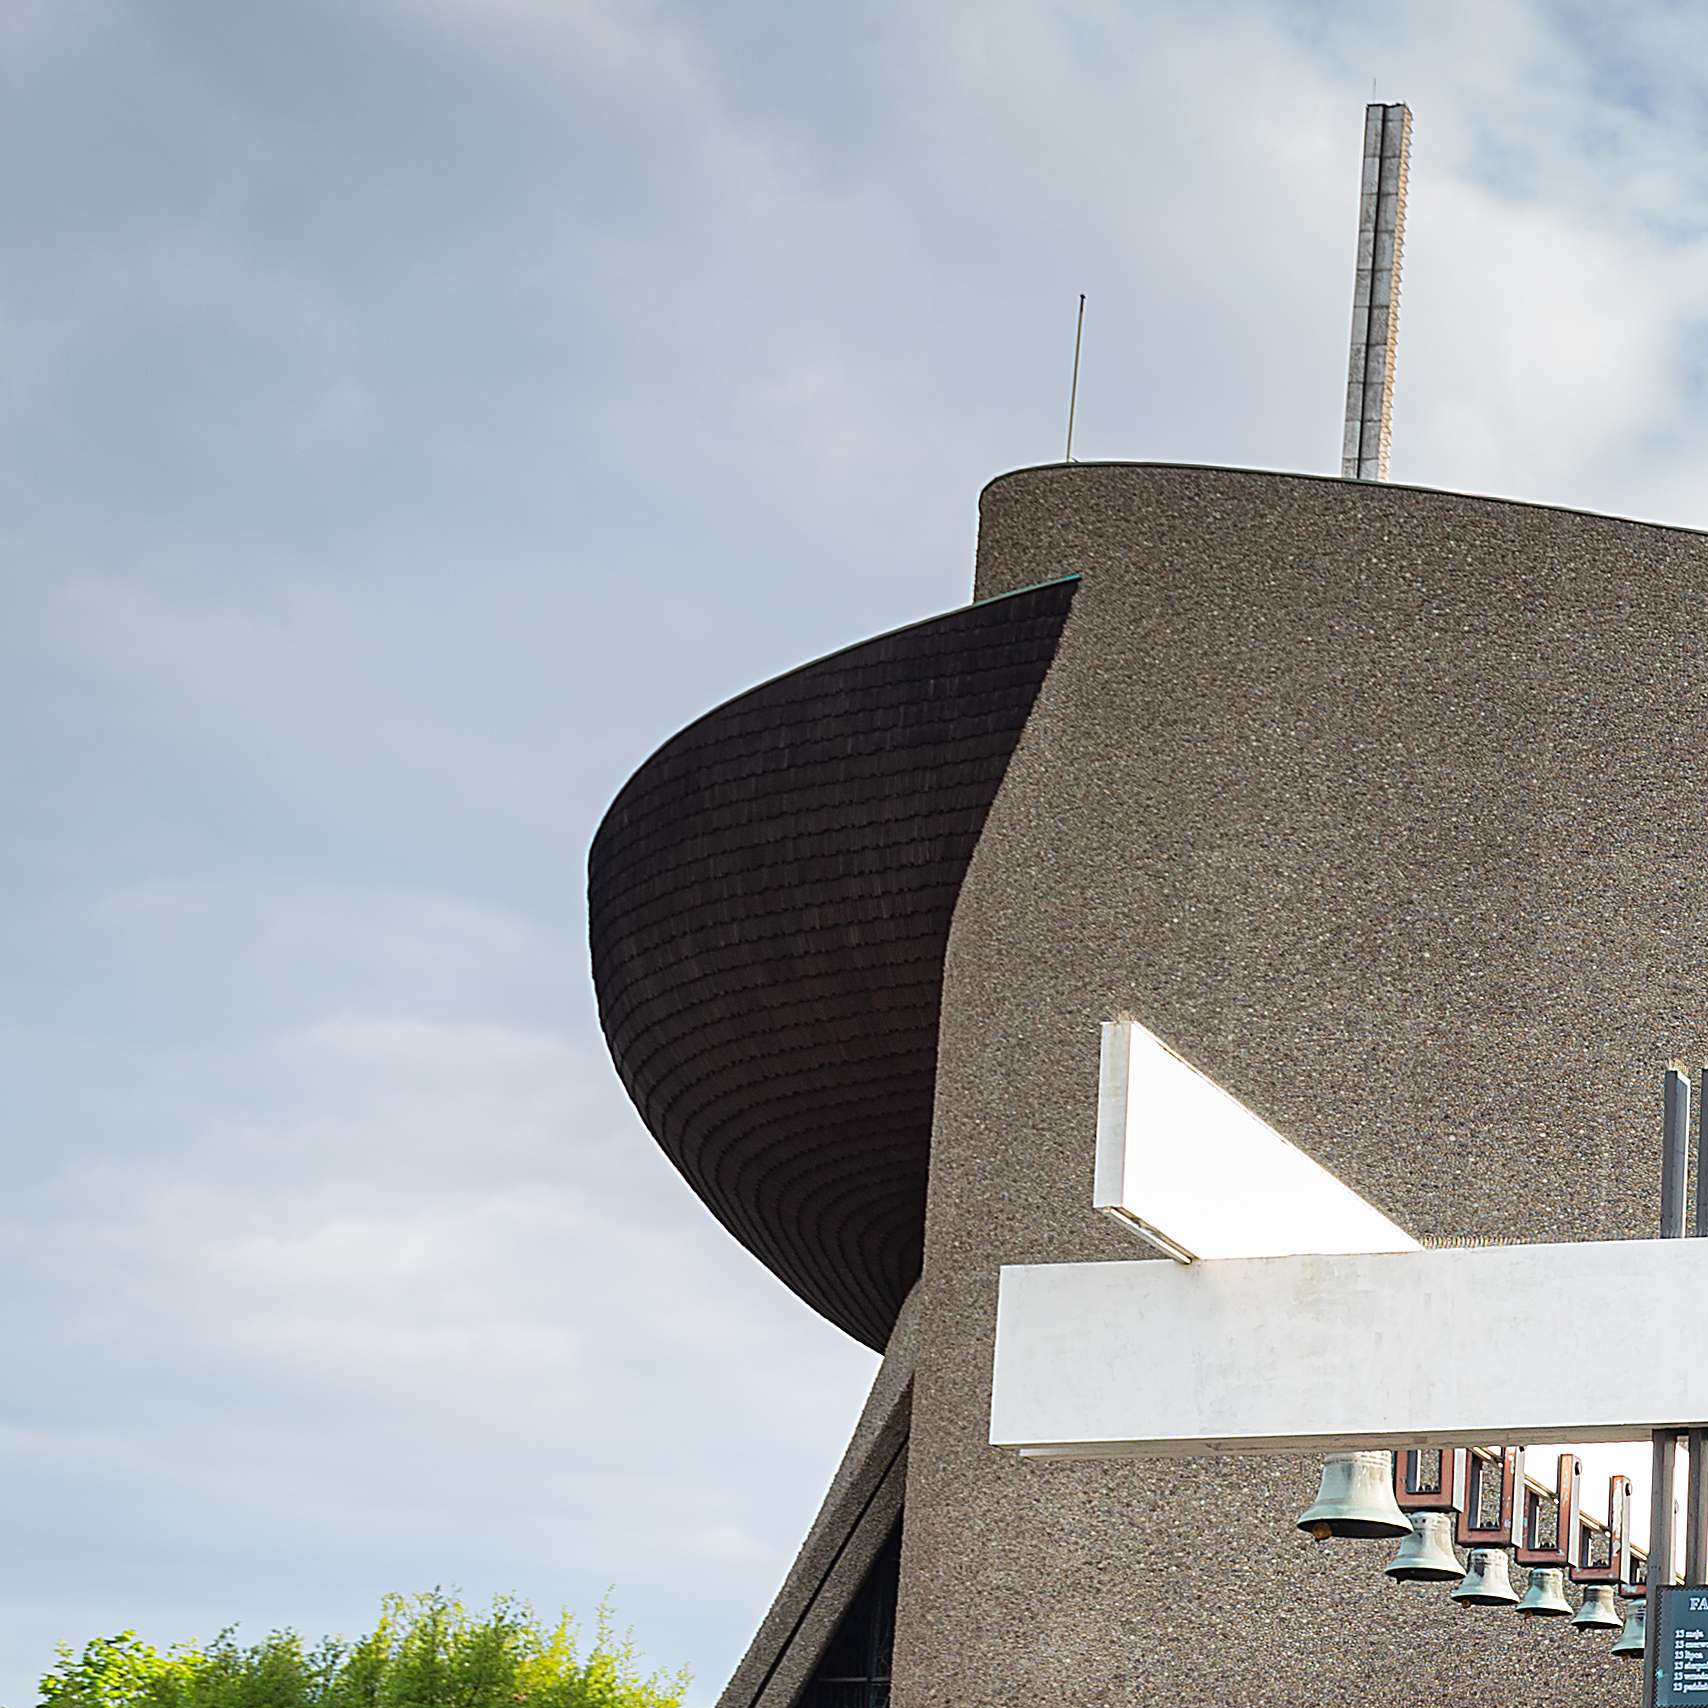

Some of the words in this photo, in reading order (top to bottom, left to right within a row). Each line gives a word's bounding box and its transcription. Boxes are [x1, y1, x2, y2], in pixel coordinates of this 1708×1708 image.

[1675, 1630, 1684, 1638] 13
[1686, 1630, 1704, 1640] maja
[1674, 1651, 1683, 1659] 13
[1685, 1651, 1703, 1661] lipca
[1674, 1662, 1683, 1670] 13
[1674, 1672, 1683, 1680] 13
[1673, 1682, 1682, 1691] 13
